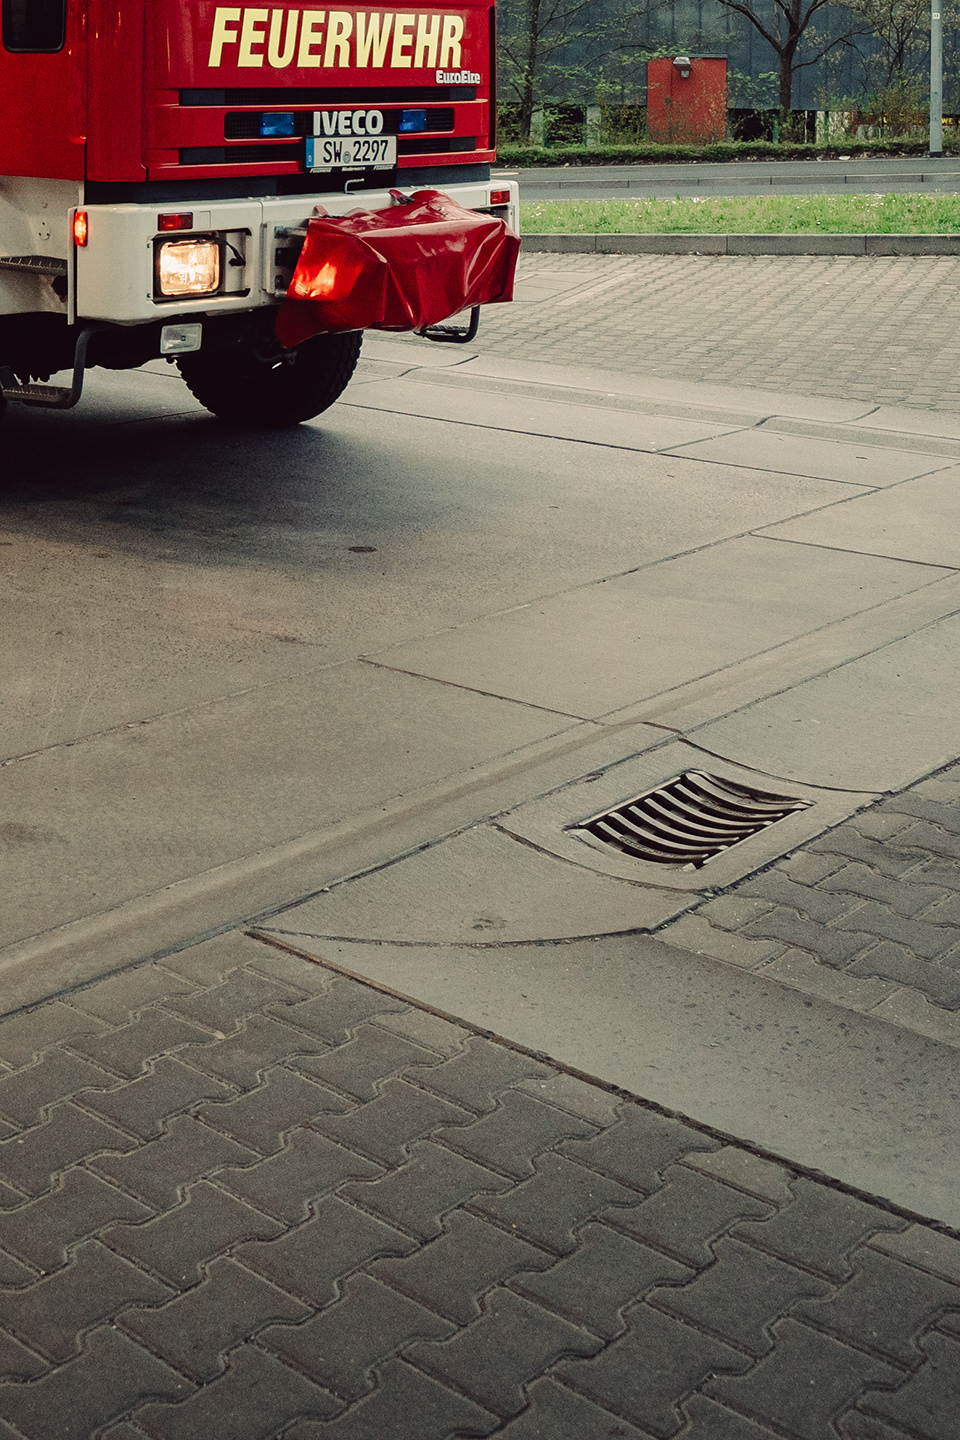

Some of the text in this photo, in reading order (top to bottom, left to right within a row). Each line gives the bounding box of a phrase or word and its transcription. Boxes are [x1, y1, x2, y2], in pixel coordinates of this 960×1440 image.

[208, 7, 464, 69] FEUERWEHR
[313, 110, 384, 136] IVECO
[323, 141, 343, 163] SW
[353, 140, 389, 162] 2297
